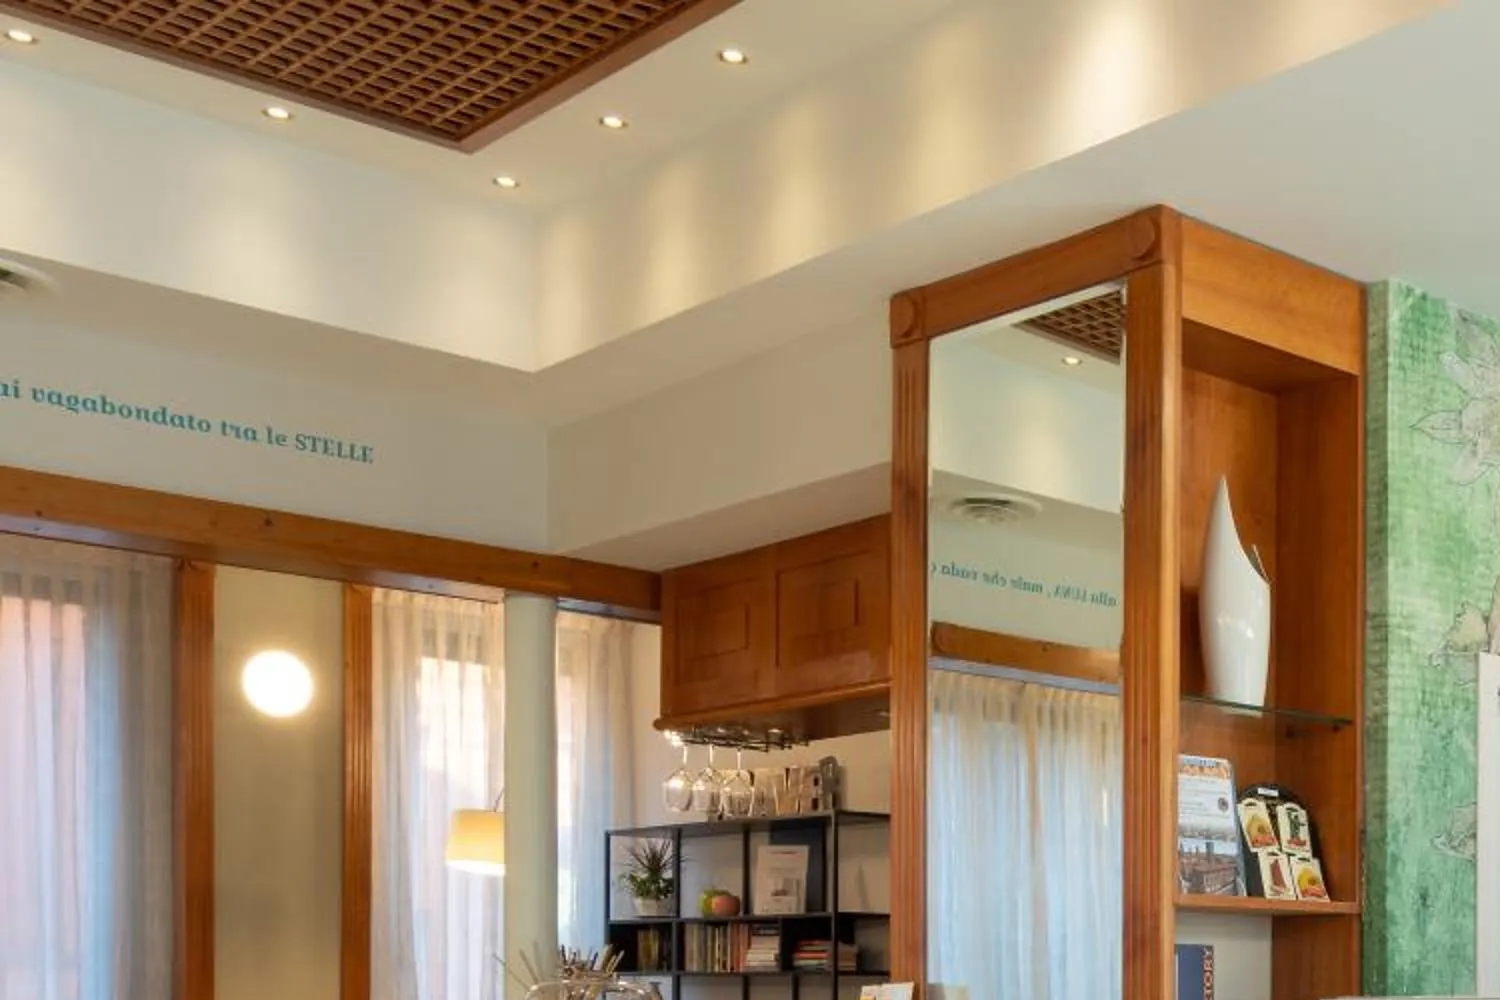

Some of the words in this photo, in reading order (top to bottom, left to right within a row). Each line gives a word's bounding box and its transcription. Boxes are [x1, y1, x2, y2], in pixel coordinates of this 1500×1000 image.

[32, 387, 210, 433] vagabondato
[220, 420, 257, 442] tra
[266, 427, 288, 447] le
[295, 433, 374, 464] STELLE
